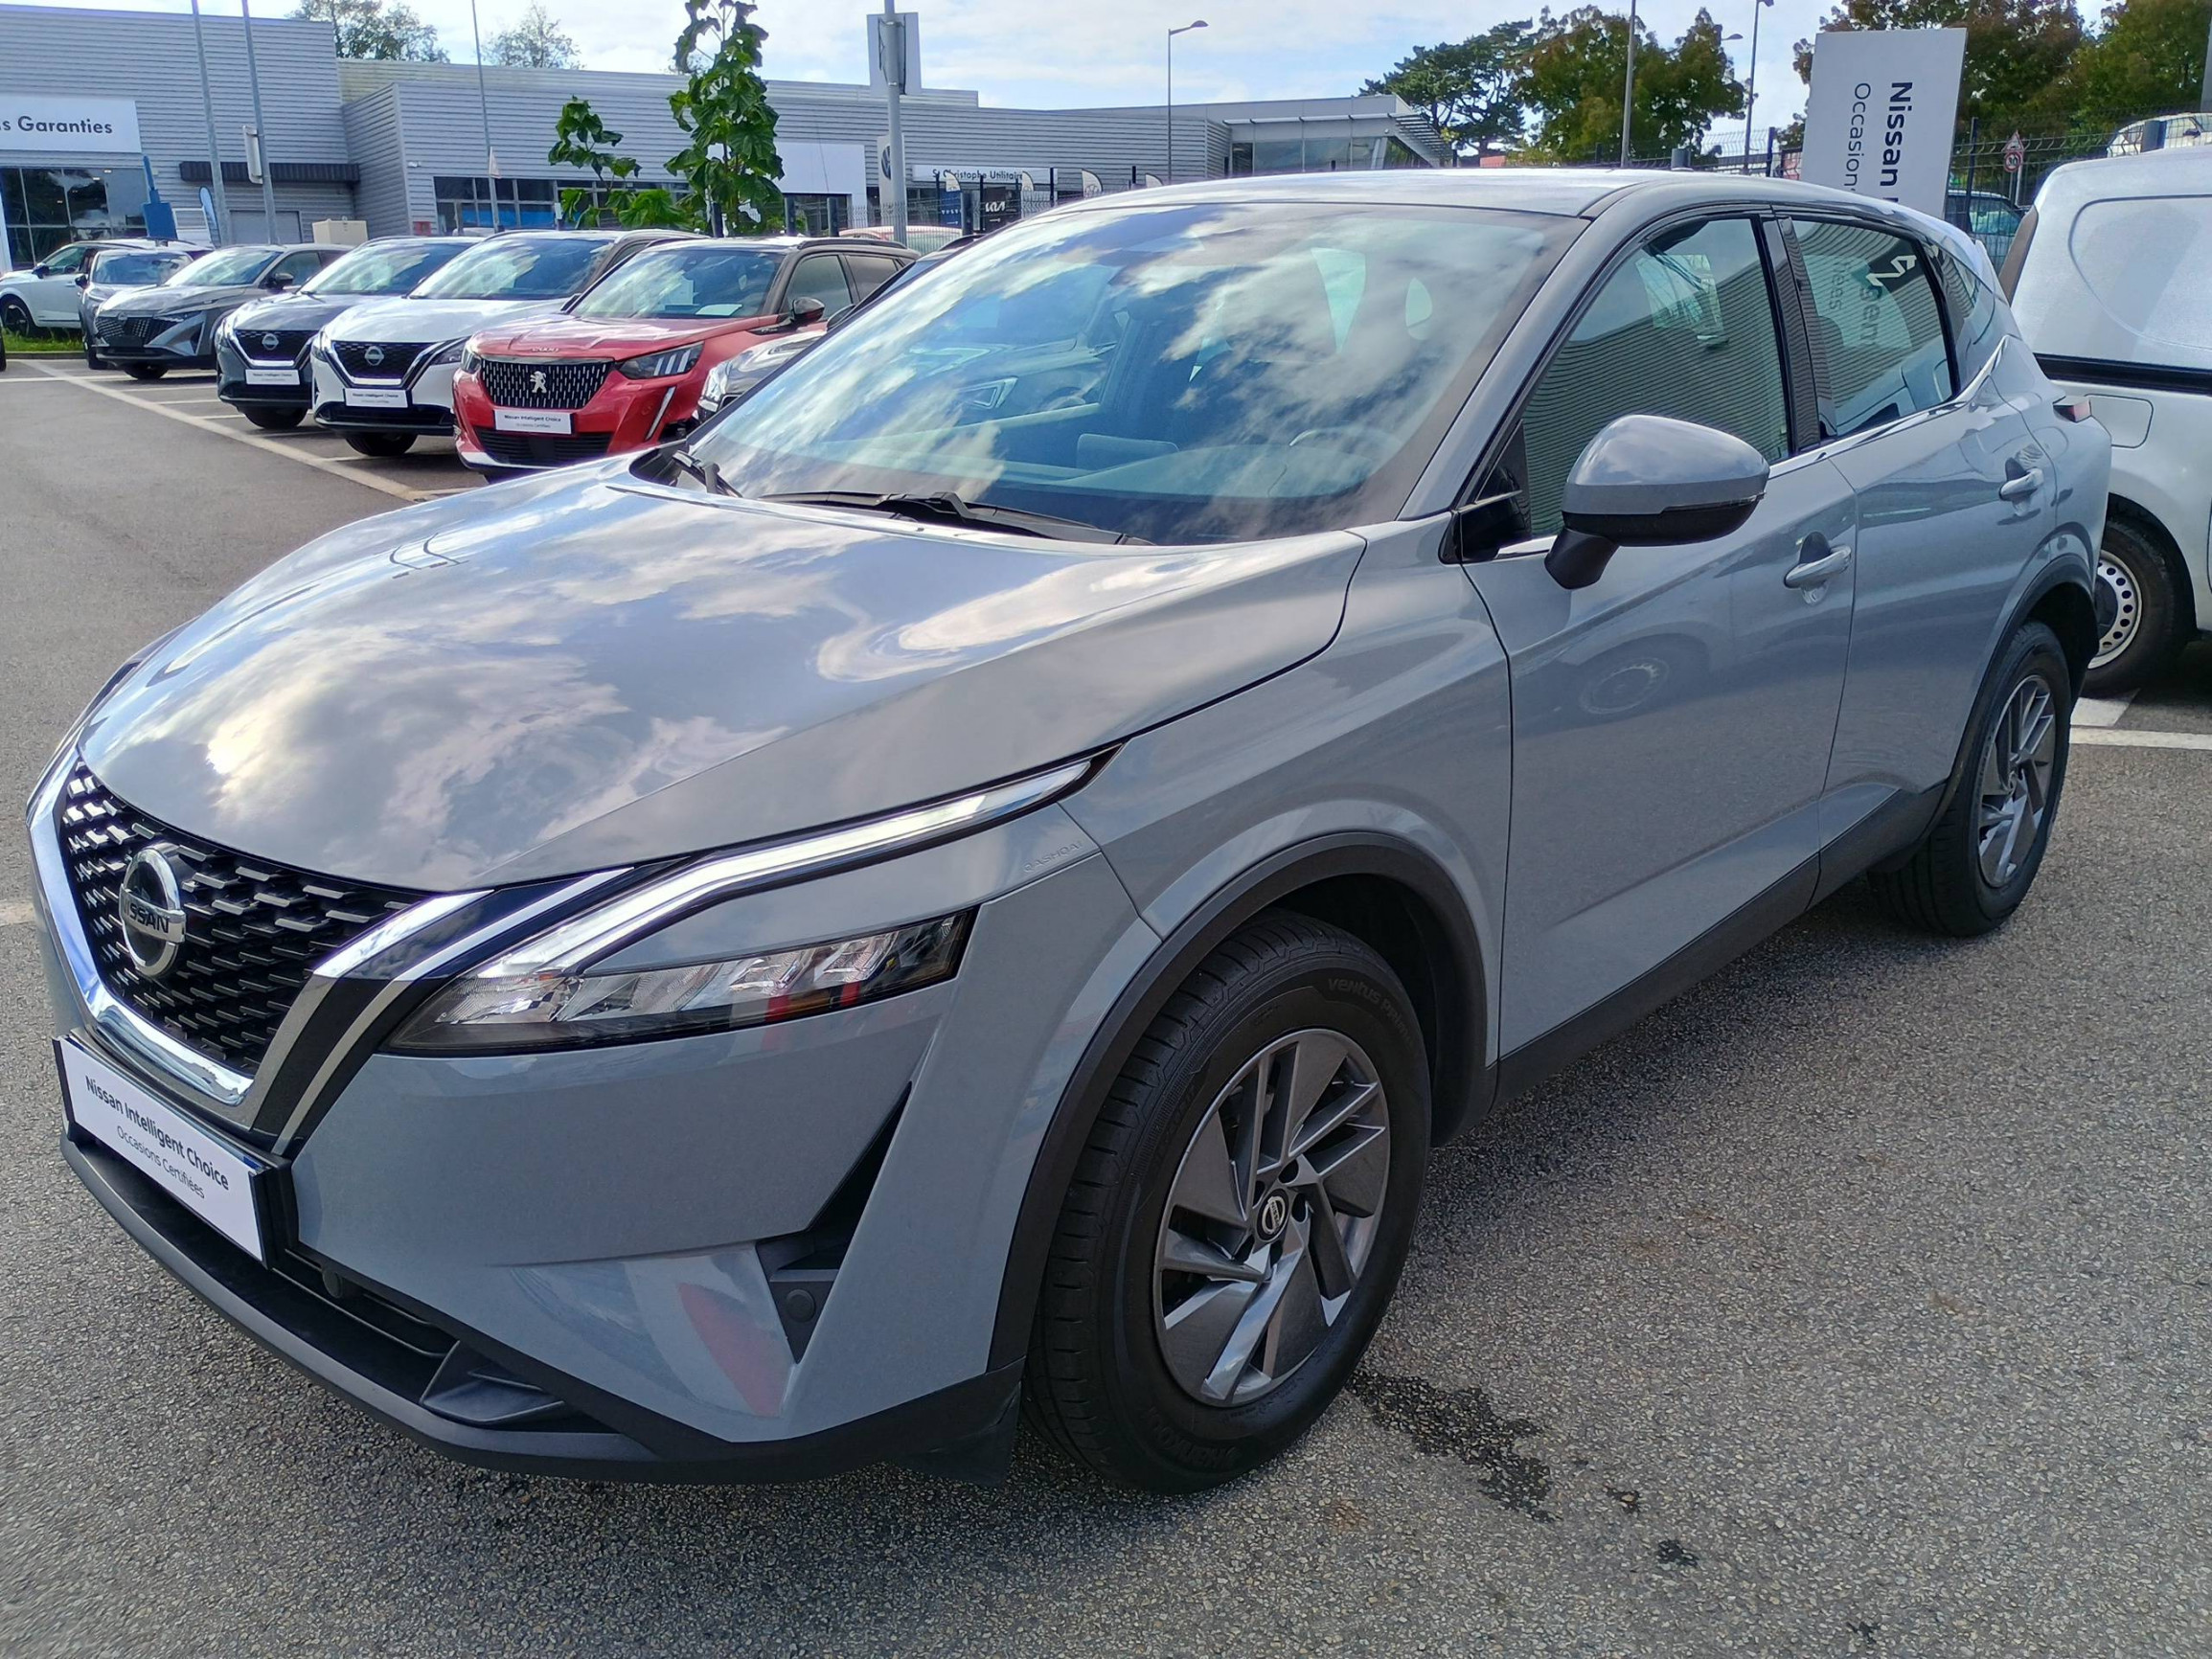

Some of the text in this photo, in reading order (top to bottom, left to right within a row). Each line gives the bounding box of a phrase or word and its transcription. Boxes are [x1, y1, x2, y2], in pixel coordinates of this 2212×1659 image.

[0, 115, 113, 134] s Garanties
[1843, 82, 1871, 191] Occasion
[1880, 81, 1913, 187] Nissan
[943, 169, 988, 181] Cristophe
[85, 1075, 230, 1191] Nissan Intelligent Choice
[117, 1125, 205, 1198] Occasions Certifiées
